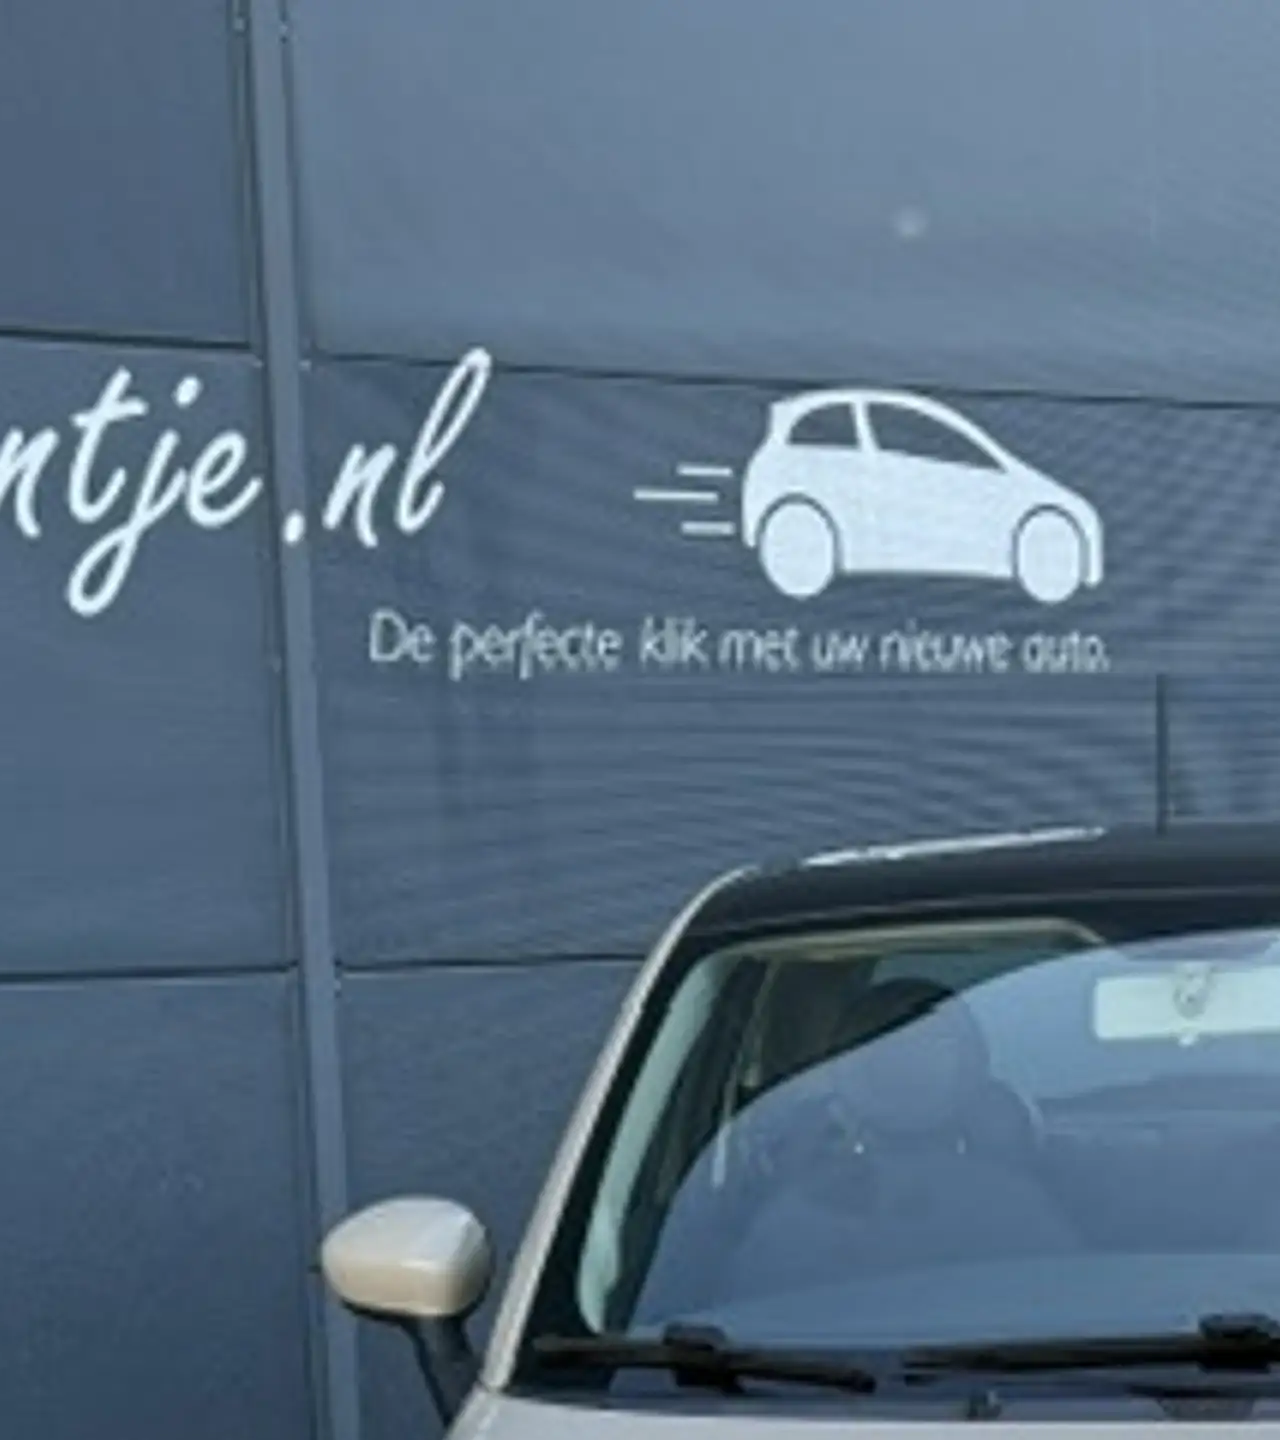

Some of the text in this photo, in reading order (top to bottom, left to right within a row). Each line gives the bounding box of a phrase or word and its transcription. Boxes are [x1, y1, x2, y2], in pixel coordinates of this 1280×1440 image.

[368, 608, 436, 663] De
[448, 610, 624, 682] perfecte
[639, 614, 709, 665] klik
[718, 626, 801, 672] met
[812, 632, 870, 673] uw
[879, 617, 1014, 674] nieuwe
